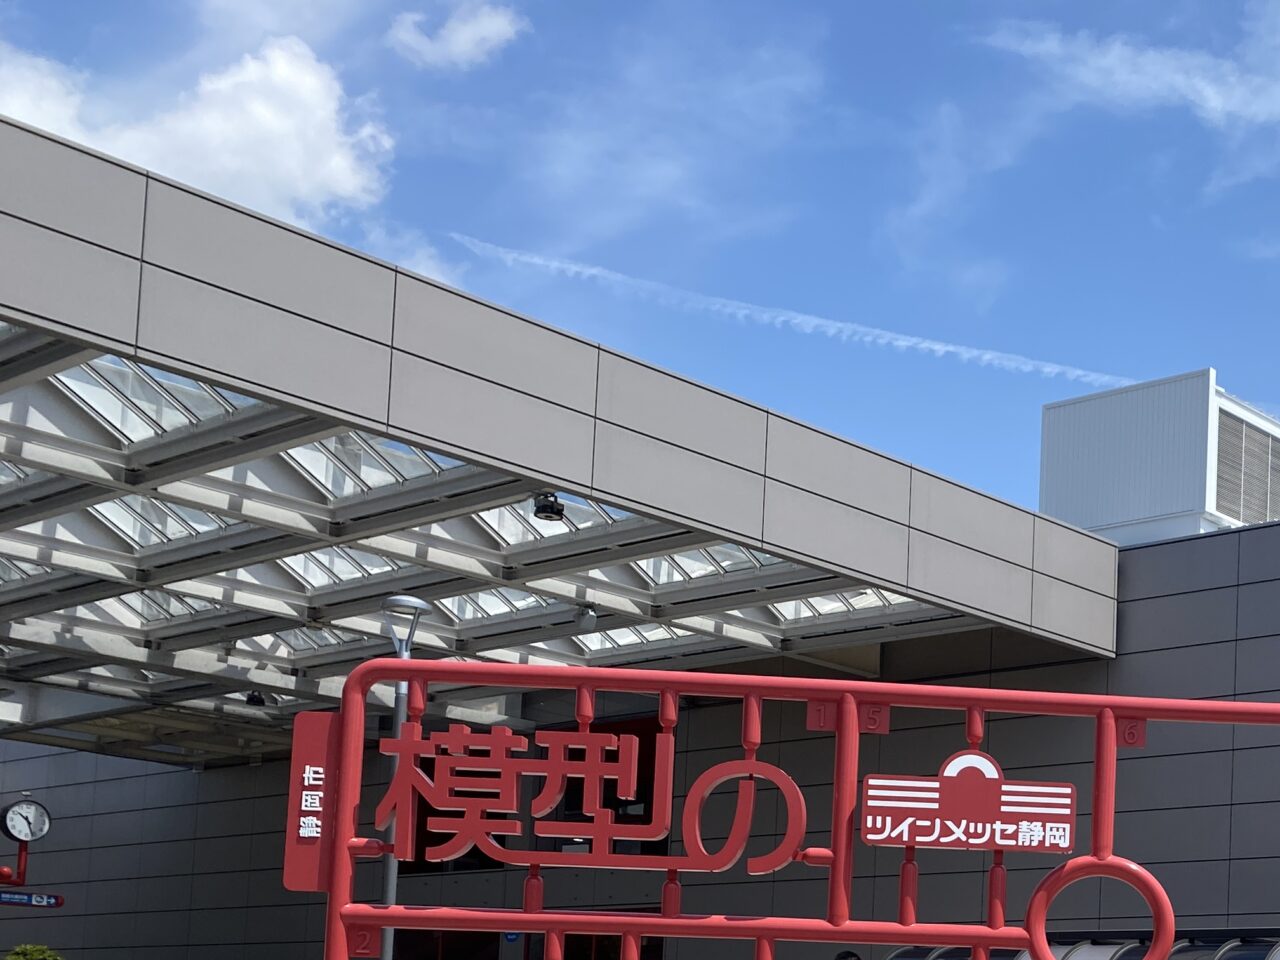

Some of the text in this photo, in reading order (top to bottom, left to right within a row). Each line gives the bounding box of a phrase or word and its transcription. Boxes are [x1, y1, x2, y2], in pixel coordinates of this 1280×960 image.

[866, 706, 882, 730] 5
[1123, 721, 1139, 745] 6
[299, 765, 326, 838] 静岡市
[375, 722, 807, 876] 模型の
[866, 815, 1071, 848] ツインメッセ静岡
[355, 931, 371, 953] 2
